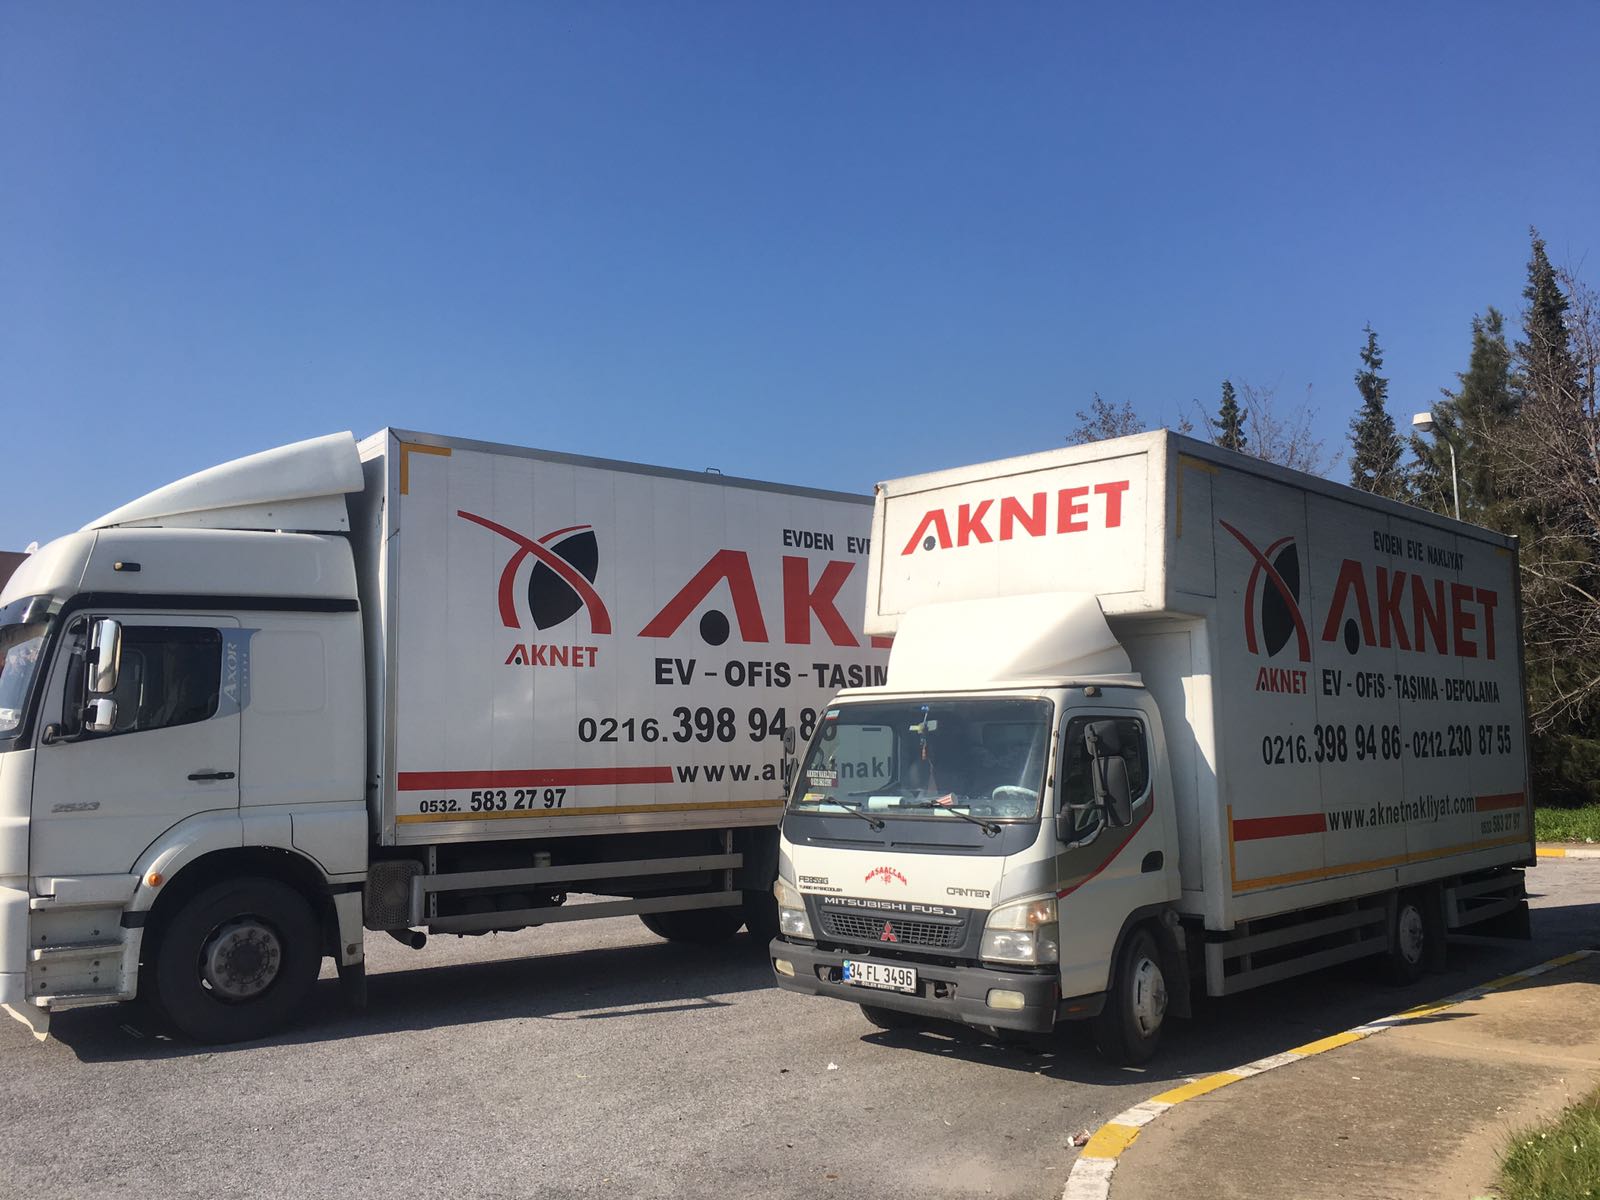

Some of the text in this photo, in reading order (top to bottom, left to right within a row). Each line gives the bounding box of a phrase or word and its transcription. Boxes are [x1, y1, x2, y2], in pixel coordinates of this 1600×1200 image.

[901, 480, 1130, 556] AKNET
[782, 528, 834, 551] EVDEN
[1373, 531, 1402, 557] EVDEN
[1407, 540, 1423, 561] EVE
[1321, 558, 1498, 660] AKNET
[504, 643, 598, 668] AKNET
[223, 642, 237, 702] AXOR
[655, 657, 696, 685] EV
[1256, 667, 1307, 695] AKNET
[1322, 669, 1342, 696] EV
[1445, 678, 1500, 703] DEPOLAMA
[748, 707, 787, 742] 94
[1355, 725, 1377, 760] 94
[1382, 725, 1400, 760] 86
[1479, 725, 1493, 756] 87
[1497, 725, 1512, 754] 55
[470, 790, 507, 812] 583
[513, 789, 537, 810] 27
[543, 788, 567, 809] 97
[1328, 795, 1475, 831] www.aknetnakliyat.com
[825, 897, 906, 911] MITSUBISHI
[946, 887, 990, 898] CANTER
[849, 963, 912, 986] 34 FL 3496
